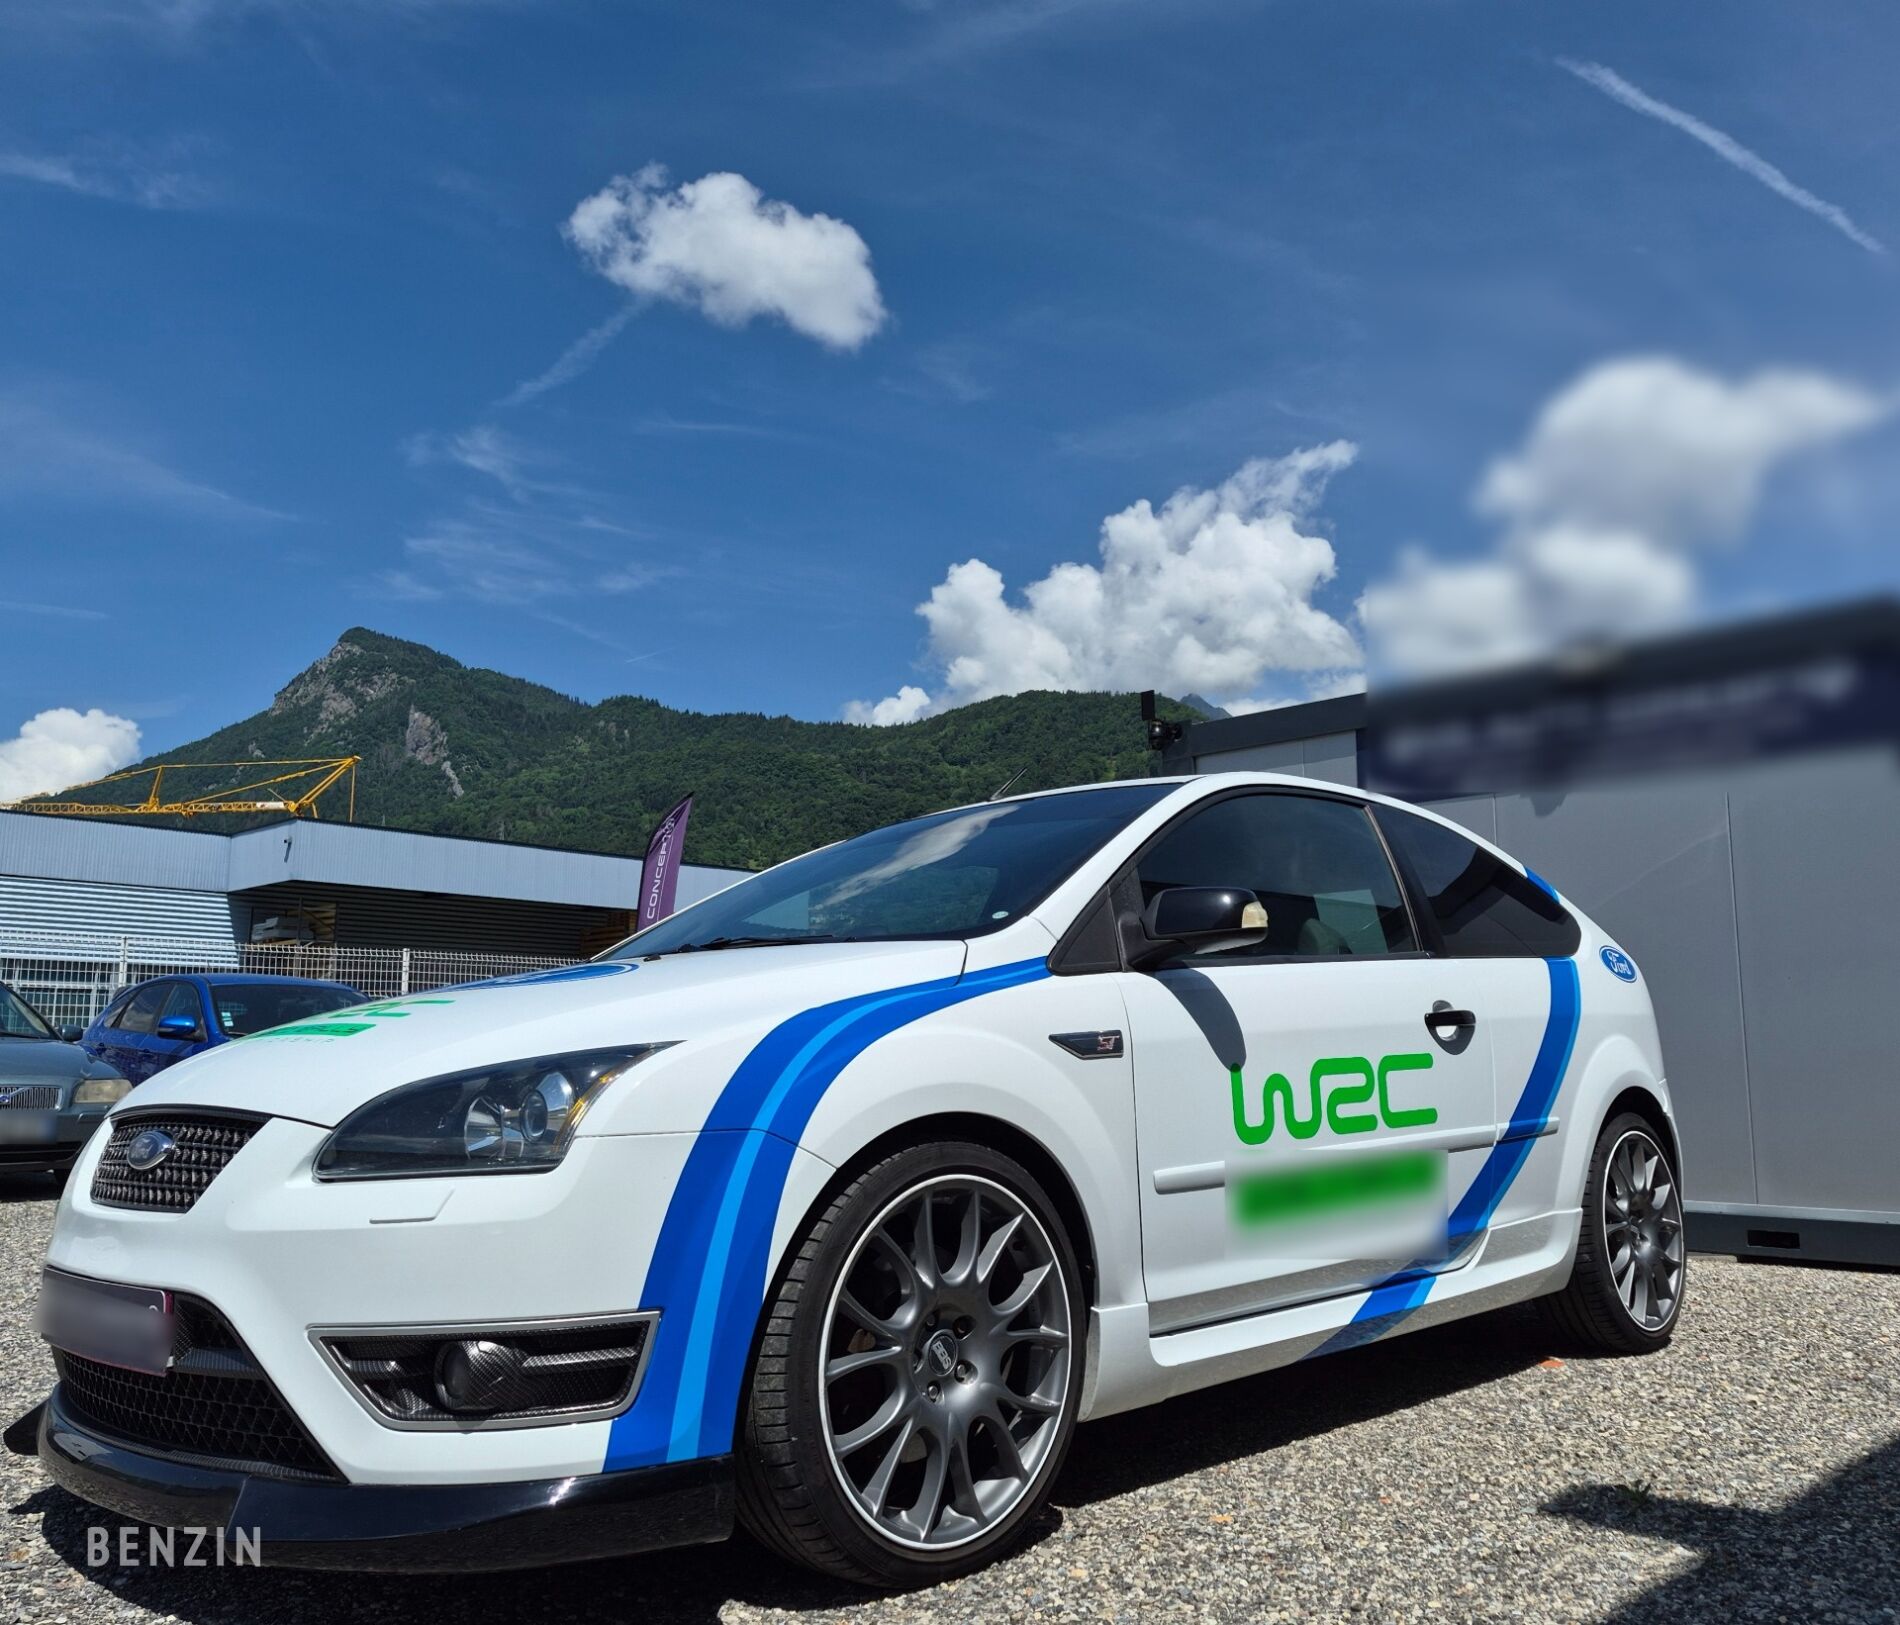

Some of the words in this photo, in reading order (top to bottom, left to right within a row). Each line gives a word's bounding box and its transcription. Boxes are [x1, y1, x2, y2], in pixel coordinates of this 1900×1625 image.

[1606, 950, 1632, 975] Ford
[1230, 1052, 1438, 1146] WRC
[932, 1340, 951, 1369] BBS
